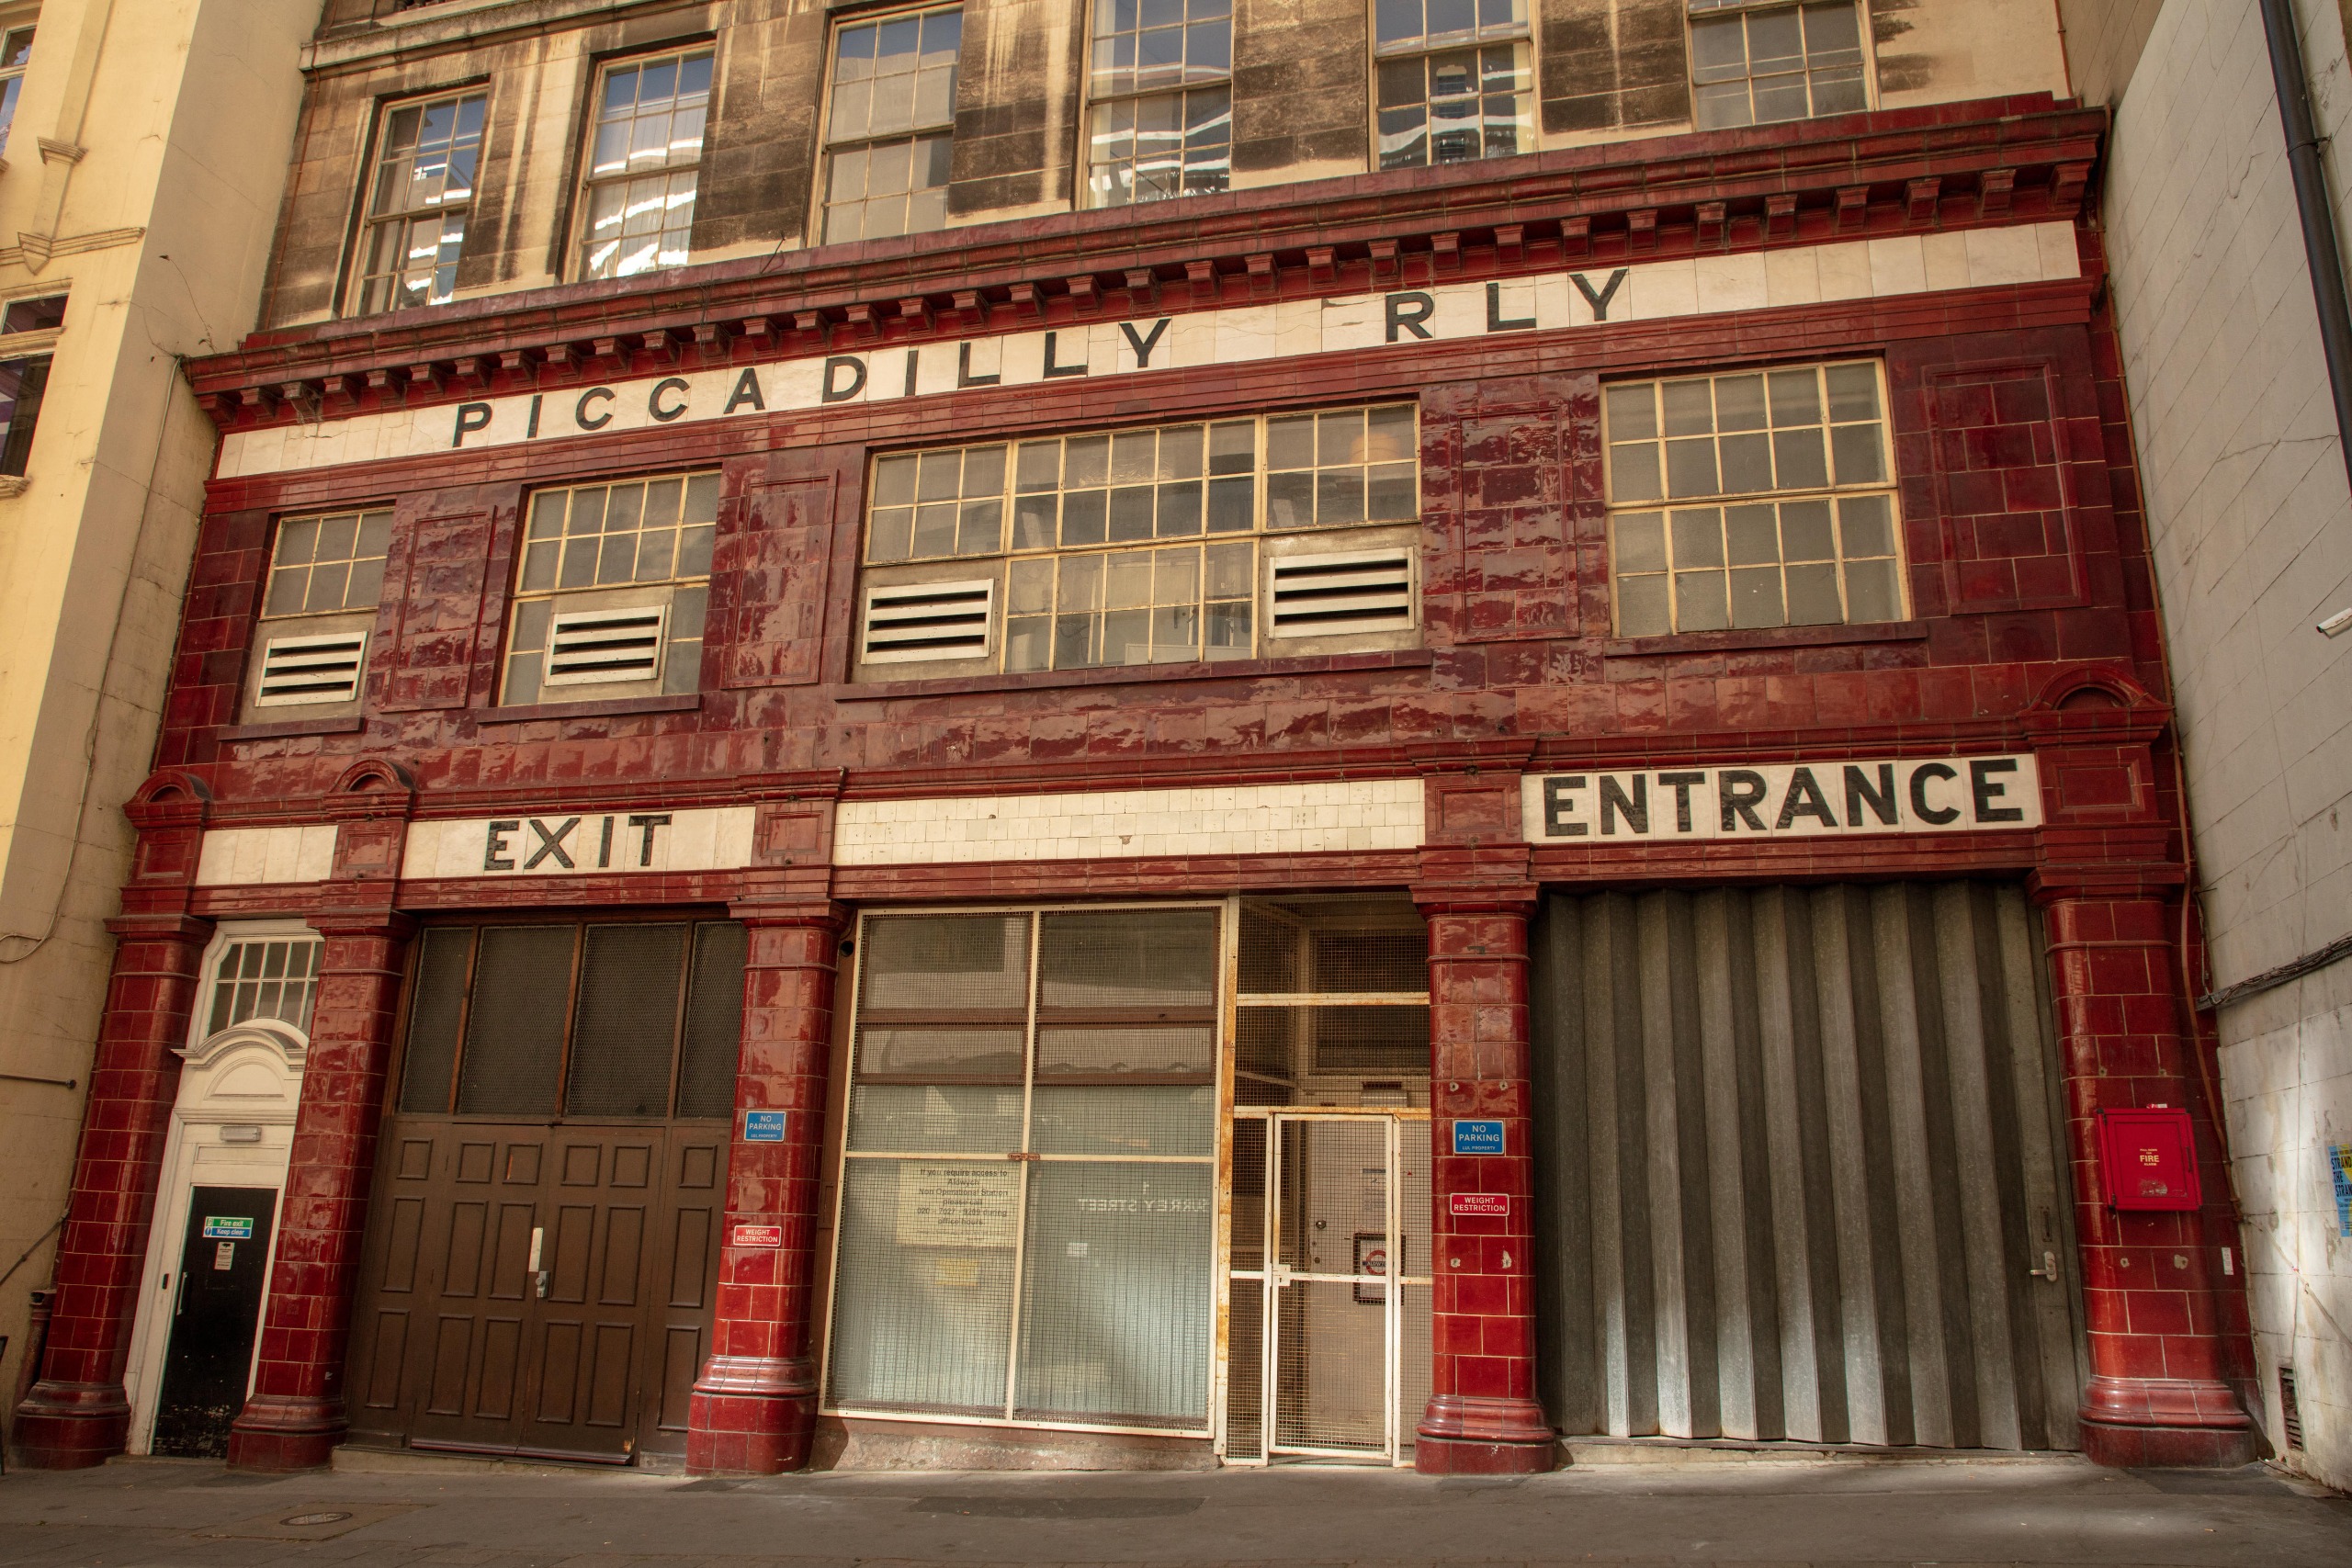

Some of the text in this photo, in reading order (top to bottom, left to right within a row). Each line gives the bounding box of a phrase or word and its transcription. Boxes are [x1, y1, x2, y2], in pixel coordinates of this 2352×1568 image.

[453, 269, 1628, 448] PICCADILLY RLY
[1543, 758, 2023, 837] ENTRANCE
[484, 814, 673, 871] EXIT
[749, 1122, 782, 1131] PARKING
[1459, 1134, 1499, 1142] PARKING
[2139, 1155, 2160, 1163] FIRE
[944, 1168, 969, 1177] require
[2334, 1171, 2344, 1183] THE
[936, 1188, 979, 1196] Operational
[980, 1188, 1008, 1197] Station
[2335, 1184, 2352, 1198] STRAN
[983, 1208, 1008, 1217] during
[938, 1217, 959, 1225] office
